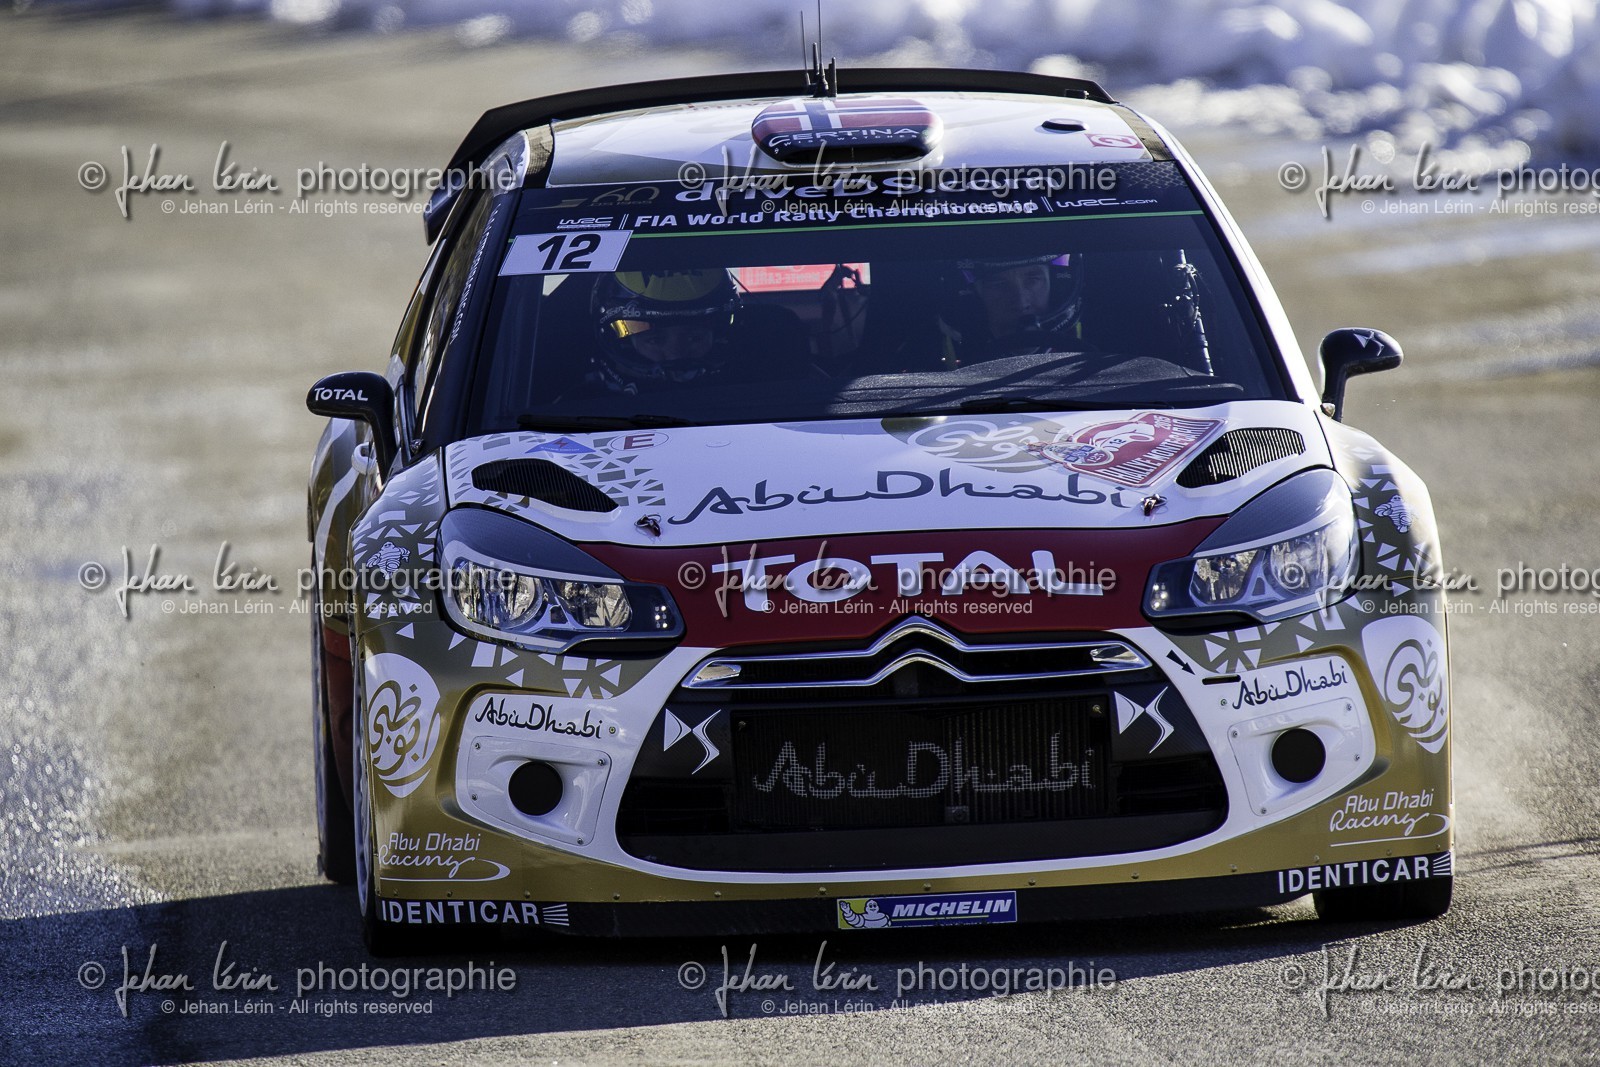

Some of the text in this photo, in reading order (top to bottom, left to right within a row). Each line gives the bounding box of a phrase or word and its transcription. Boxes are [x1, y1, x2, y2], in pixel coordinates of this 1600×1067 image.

[768, 128, 921, 148] CERTINA
[837, 134, 918, 142] WATCHES
[634, 201, 1039, 227] FIA World Rally Championship
[1055, 198, 1158, 208] WRC.com
[558, 216, 614, 225] WRC
[537, 233, 602, 271] 12
[314, 387, 369, 402] TOTAL
[623, 433, 655, 450] E
[1096, 457, 1162, 484] RALLYE
[711, 549, 1104, 612] TOTAL
[1344, 788, 1434, 815] Abu Dhabi
[1329, 809, 1430, 837] Racing
[388, 833, 481, 851] Abu Dhabi
[377, 844, 476, 879] Racing
[1278, 856, 1430, 894] IDENTICAR
[381, 900, 540, 925] IDENTICAR
[892, 899, 1012, 918] MICHELIN
